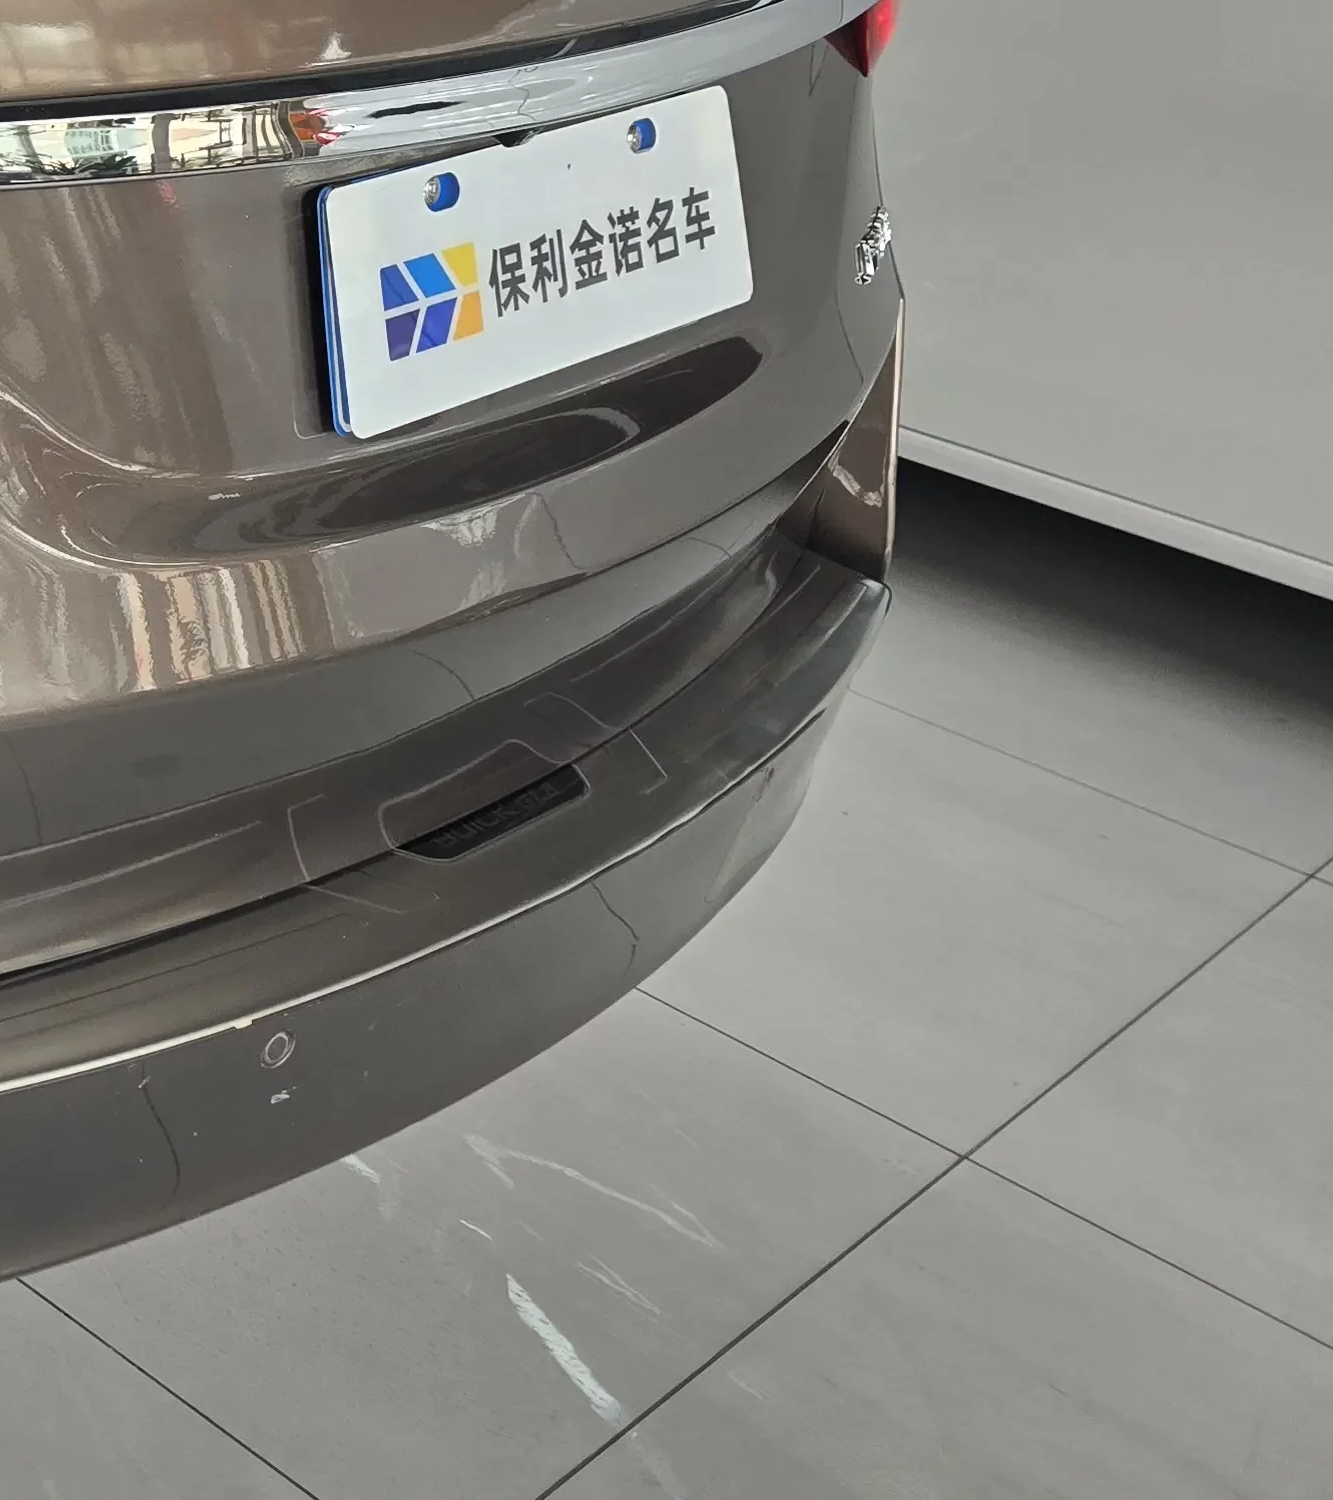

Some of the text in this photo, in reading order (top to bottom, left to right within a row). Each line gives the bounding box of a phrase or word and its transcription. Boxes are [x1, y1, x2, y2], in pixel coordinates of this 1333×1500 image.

[488, 186, 716, 317] 保利金诺名车
